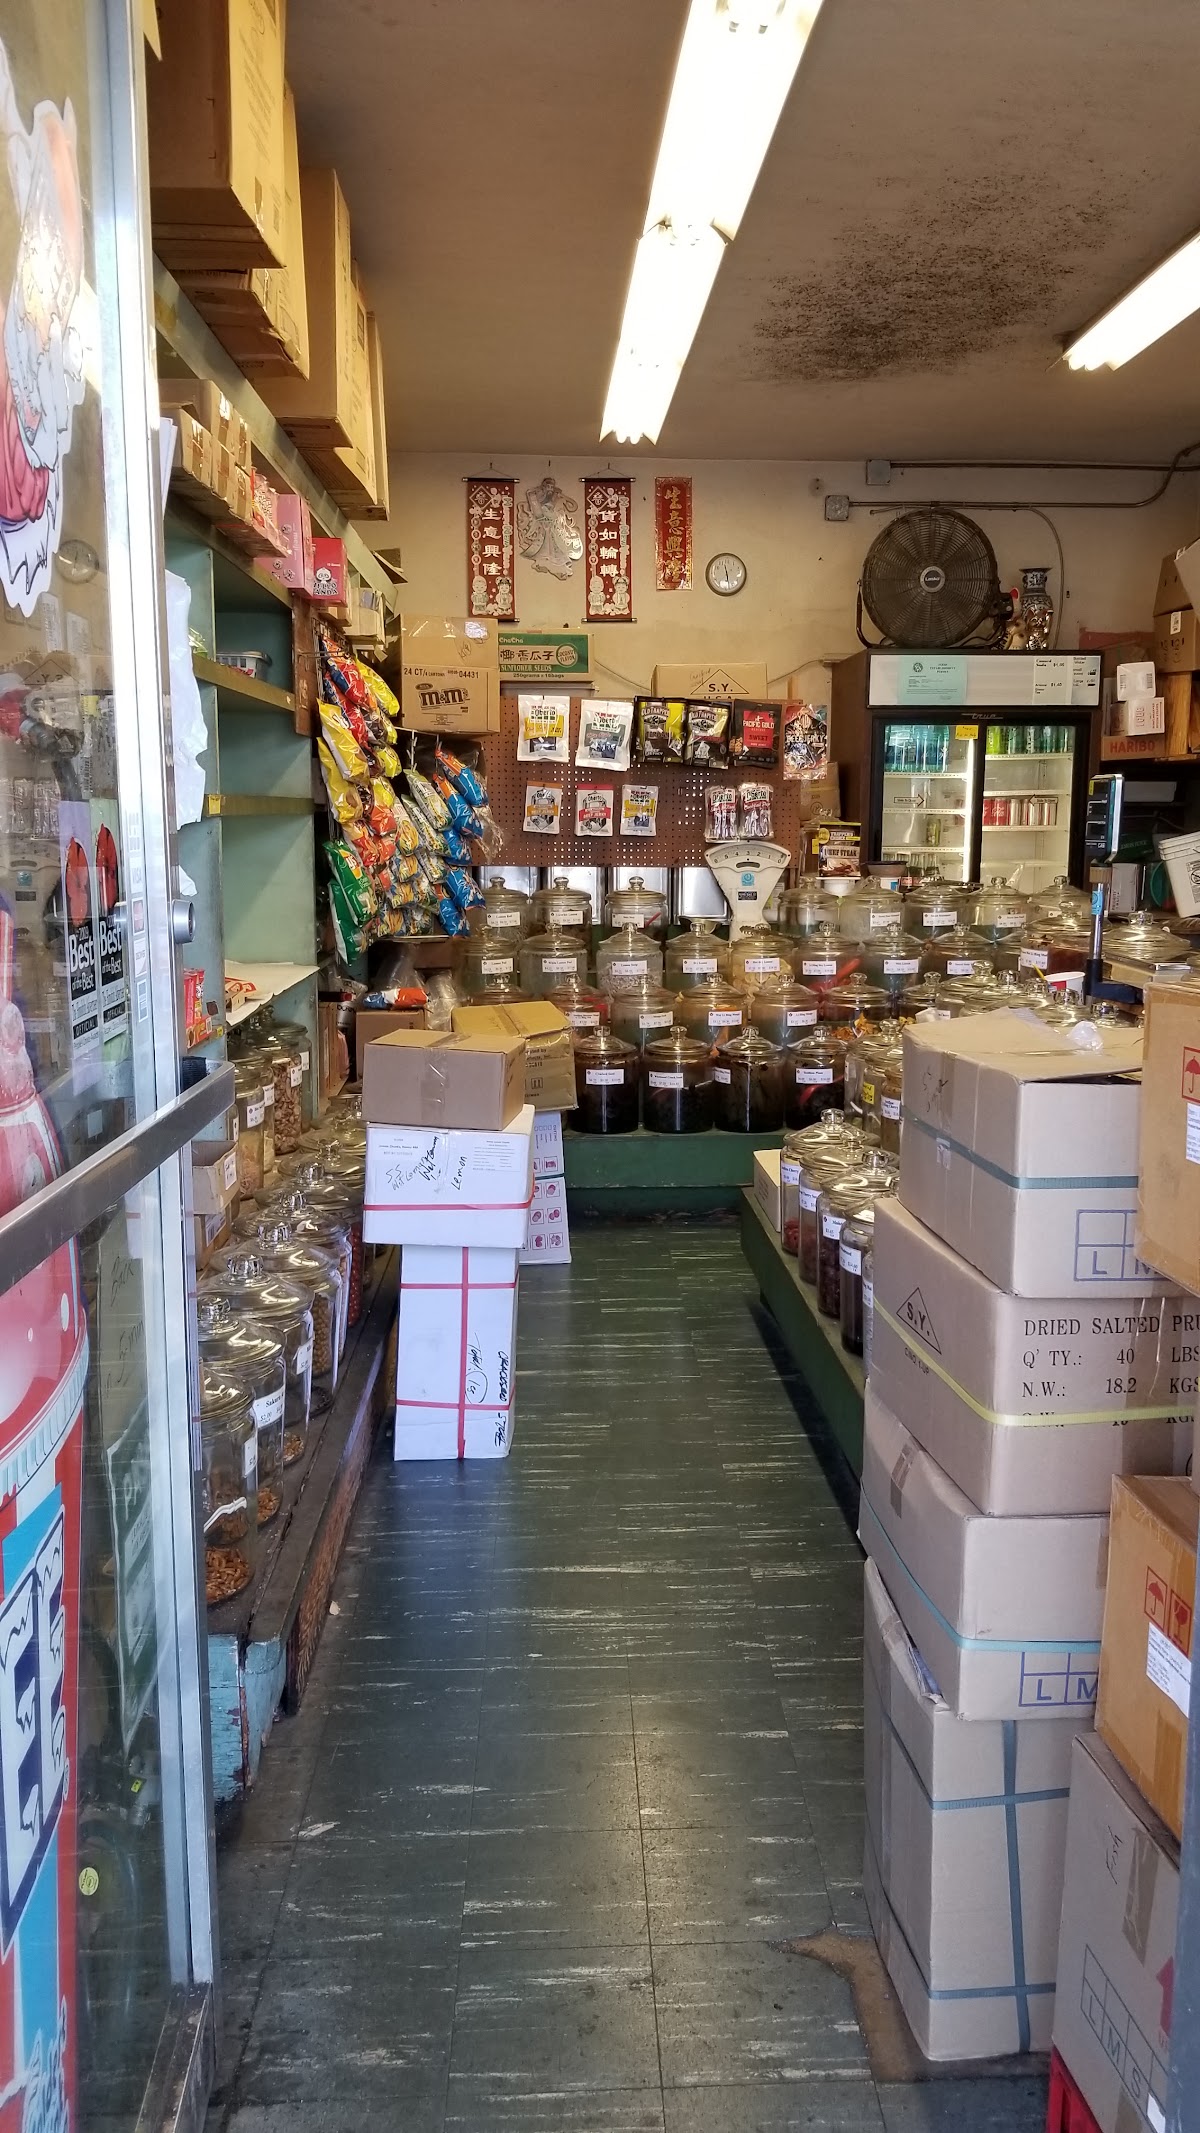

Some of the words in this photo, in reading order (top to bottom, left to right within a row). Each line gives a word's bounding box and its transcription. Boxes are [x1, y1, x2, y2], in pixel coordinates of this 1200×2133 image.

[482, 509, 502, 575] 生意興隆
[599, 510, 619, 577] 貨如輪轉
[404, 667, 412, 676] 24
[708, 683, 733, 692] S.Y.
[743, 720, 760, 728] PACIFIC
[761, 720, 775, 729] GOLD
[804, 734, 824, 743] JERKY
[1110, 741, 1155, 753] HARIBO
[841, 848, 857, 857] STEAK
[100, 921, 122, 957] Best
[69, 934, 95, 973] Best
[1092, 1251, 1107, 1275] L
[907, 1302, 930, 1336] S.Y.
[1024, 1319, 1081, 1336] DRIED
[1092, 1316, 1160, 1335] SALTED
[1116, 1348, 1135, 1364] 40
[1171, 1346, 1199, 1363] LBS
[1022, 1381, 1065, 1398] N.W.:
[1105, 1377, 1137, 1394] 18.2
[1169, 1376, 1199, 1394] KGS
[1037, 1679, 1052, 1701] L
[1077, 1678, 1098, 1700] M
[1089, 1996, 1096, 2025] L
[1108, 2027, 1121, 2064] M
[1131, 2067, 1142, 2099] S
